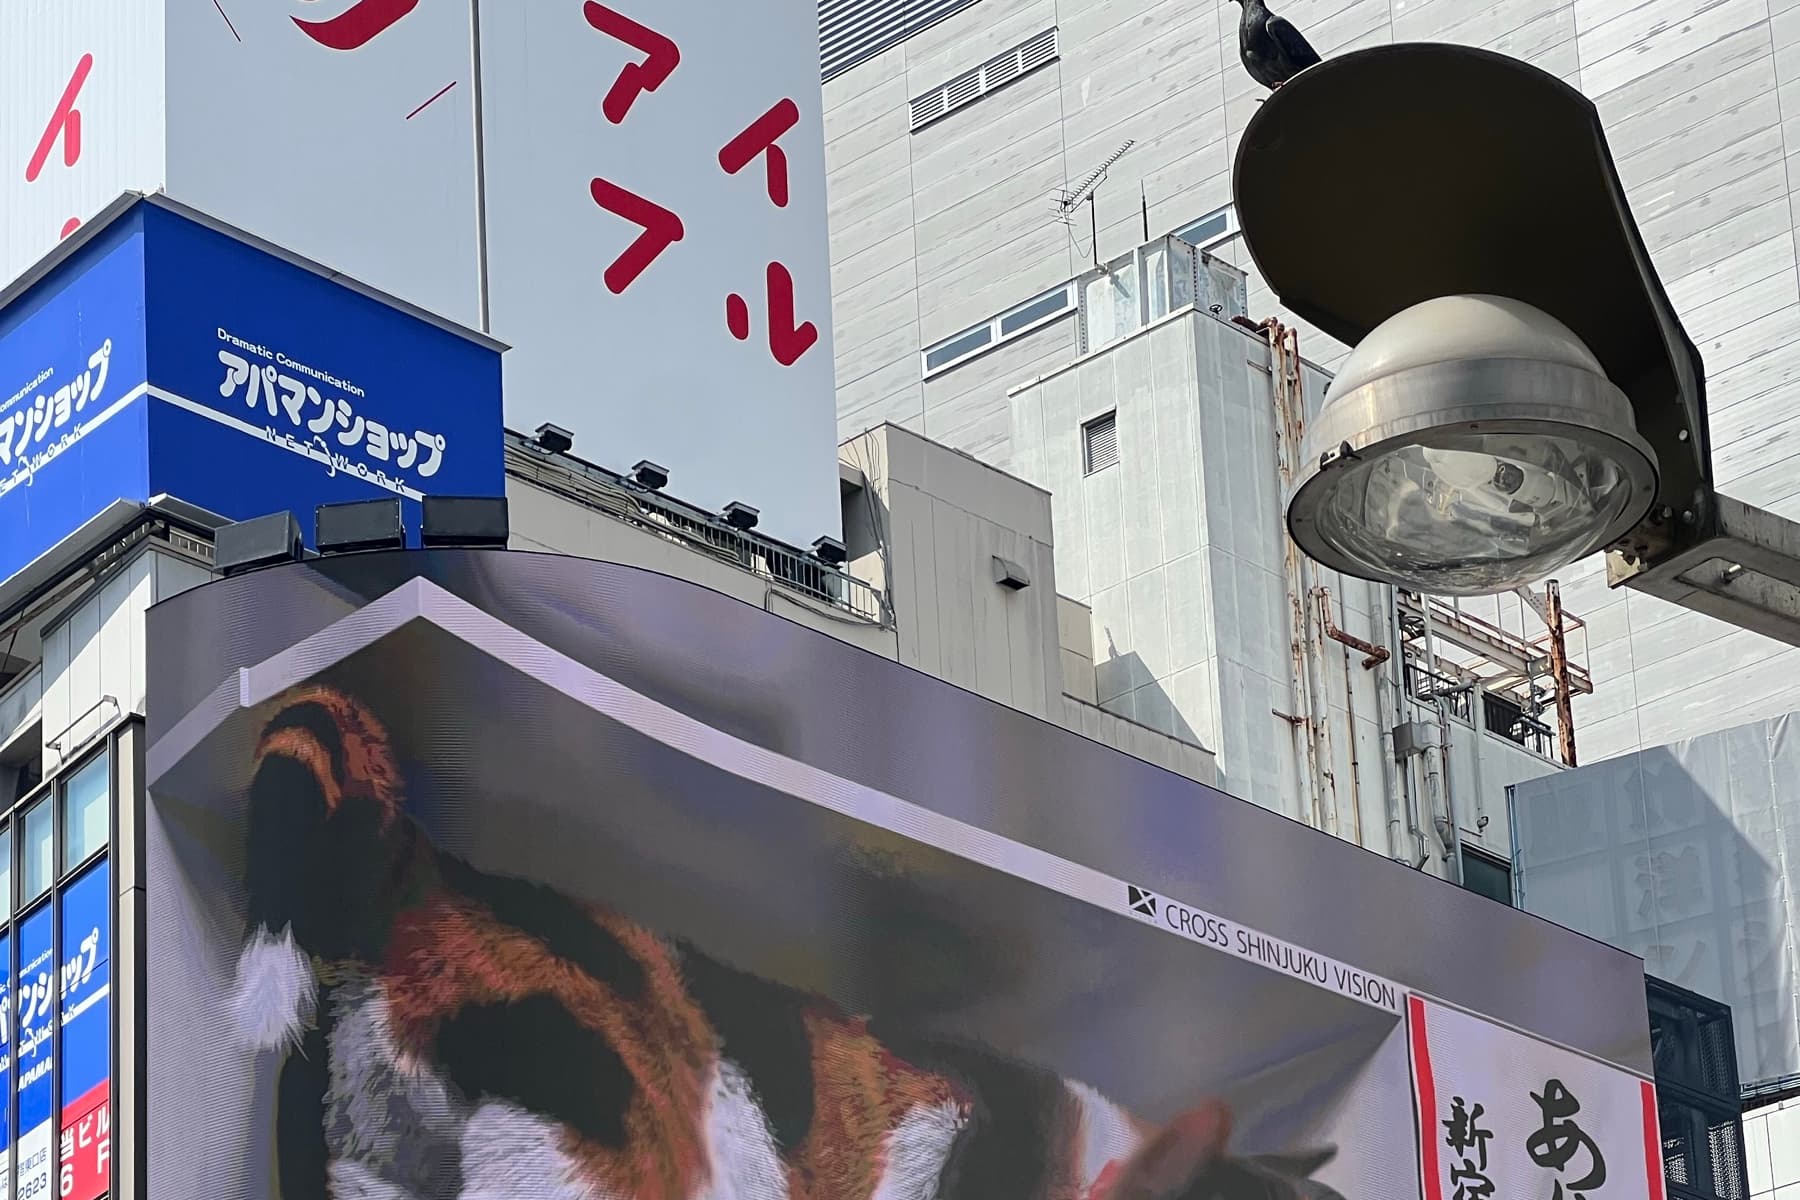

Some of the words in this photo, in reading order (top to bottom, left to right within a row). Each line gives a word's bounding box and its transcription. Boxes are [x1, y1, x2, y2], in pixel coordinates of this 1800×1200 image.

[217, 327, 273, 360] Dramatic
[275, 352, 365, 397] Communication
[218, 350, 446, 477] アパマンショップ
[1165, 904, 1229, 947] CROSS
[1237, 930, 1328, 983] SHINJUKU
[1333, 965, 1396, 1010] VISION
